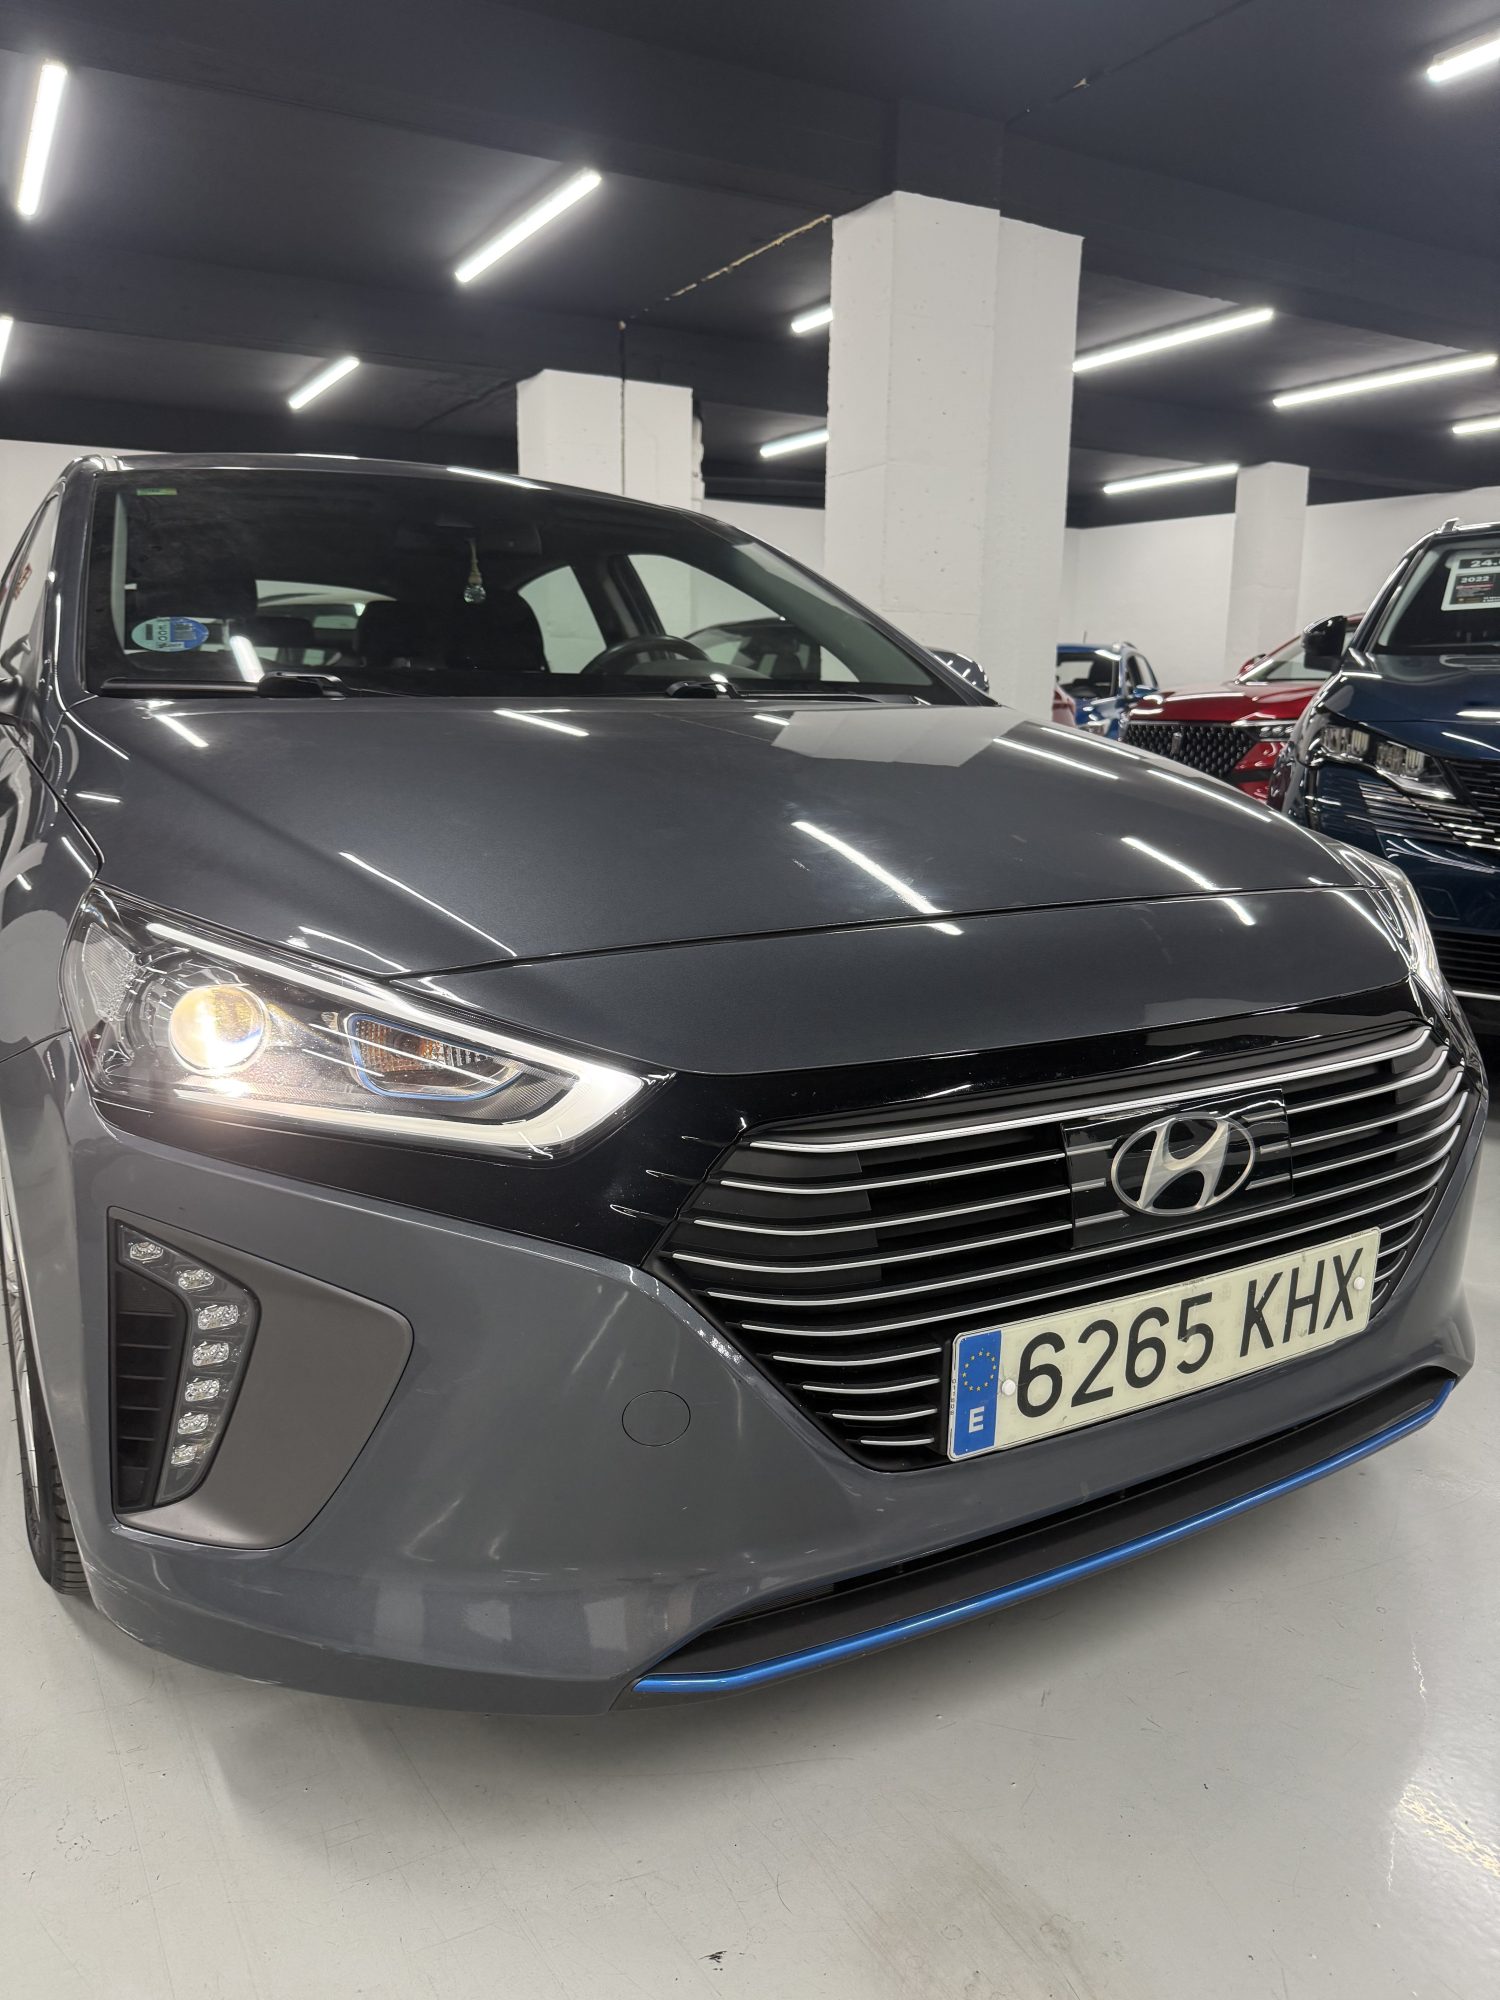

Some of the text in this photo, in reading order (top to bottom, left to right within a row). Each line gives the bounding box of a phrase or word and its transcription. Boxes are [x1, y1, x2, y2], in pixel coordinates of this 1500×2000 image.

[1470, 559, 1500, 568] 24.
[1016, 1247, 1363, 1418] 6265 KHX
[968, 1406, 985, 1434] E
